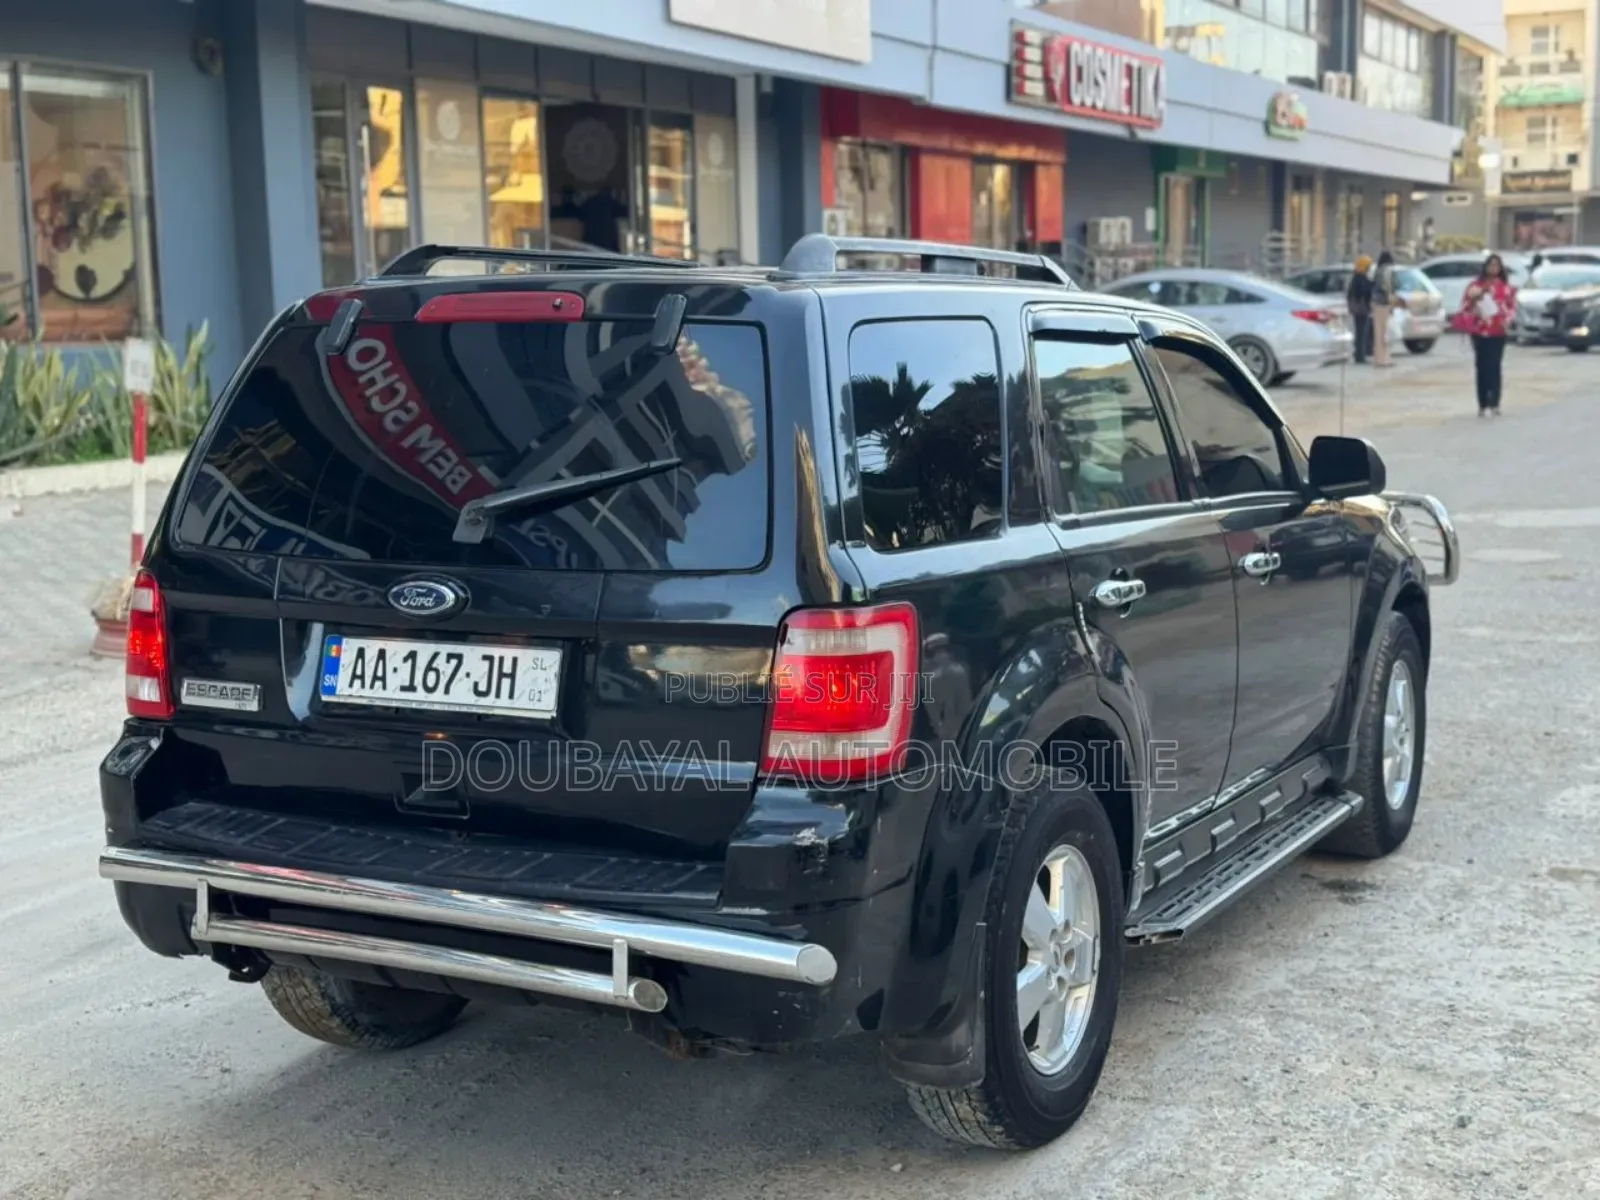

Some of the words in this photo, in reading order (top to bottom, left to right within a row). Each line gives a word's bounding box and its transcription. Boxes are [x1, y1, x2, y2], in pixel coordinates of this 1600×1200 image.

[400, 587, 436, 607] Ford
[531, 656, 547, 671] SL
[324, 674, 337, 686] SN
